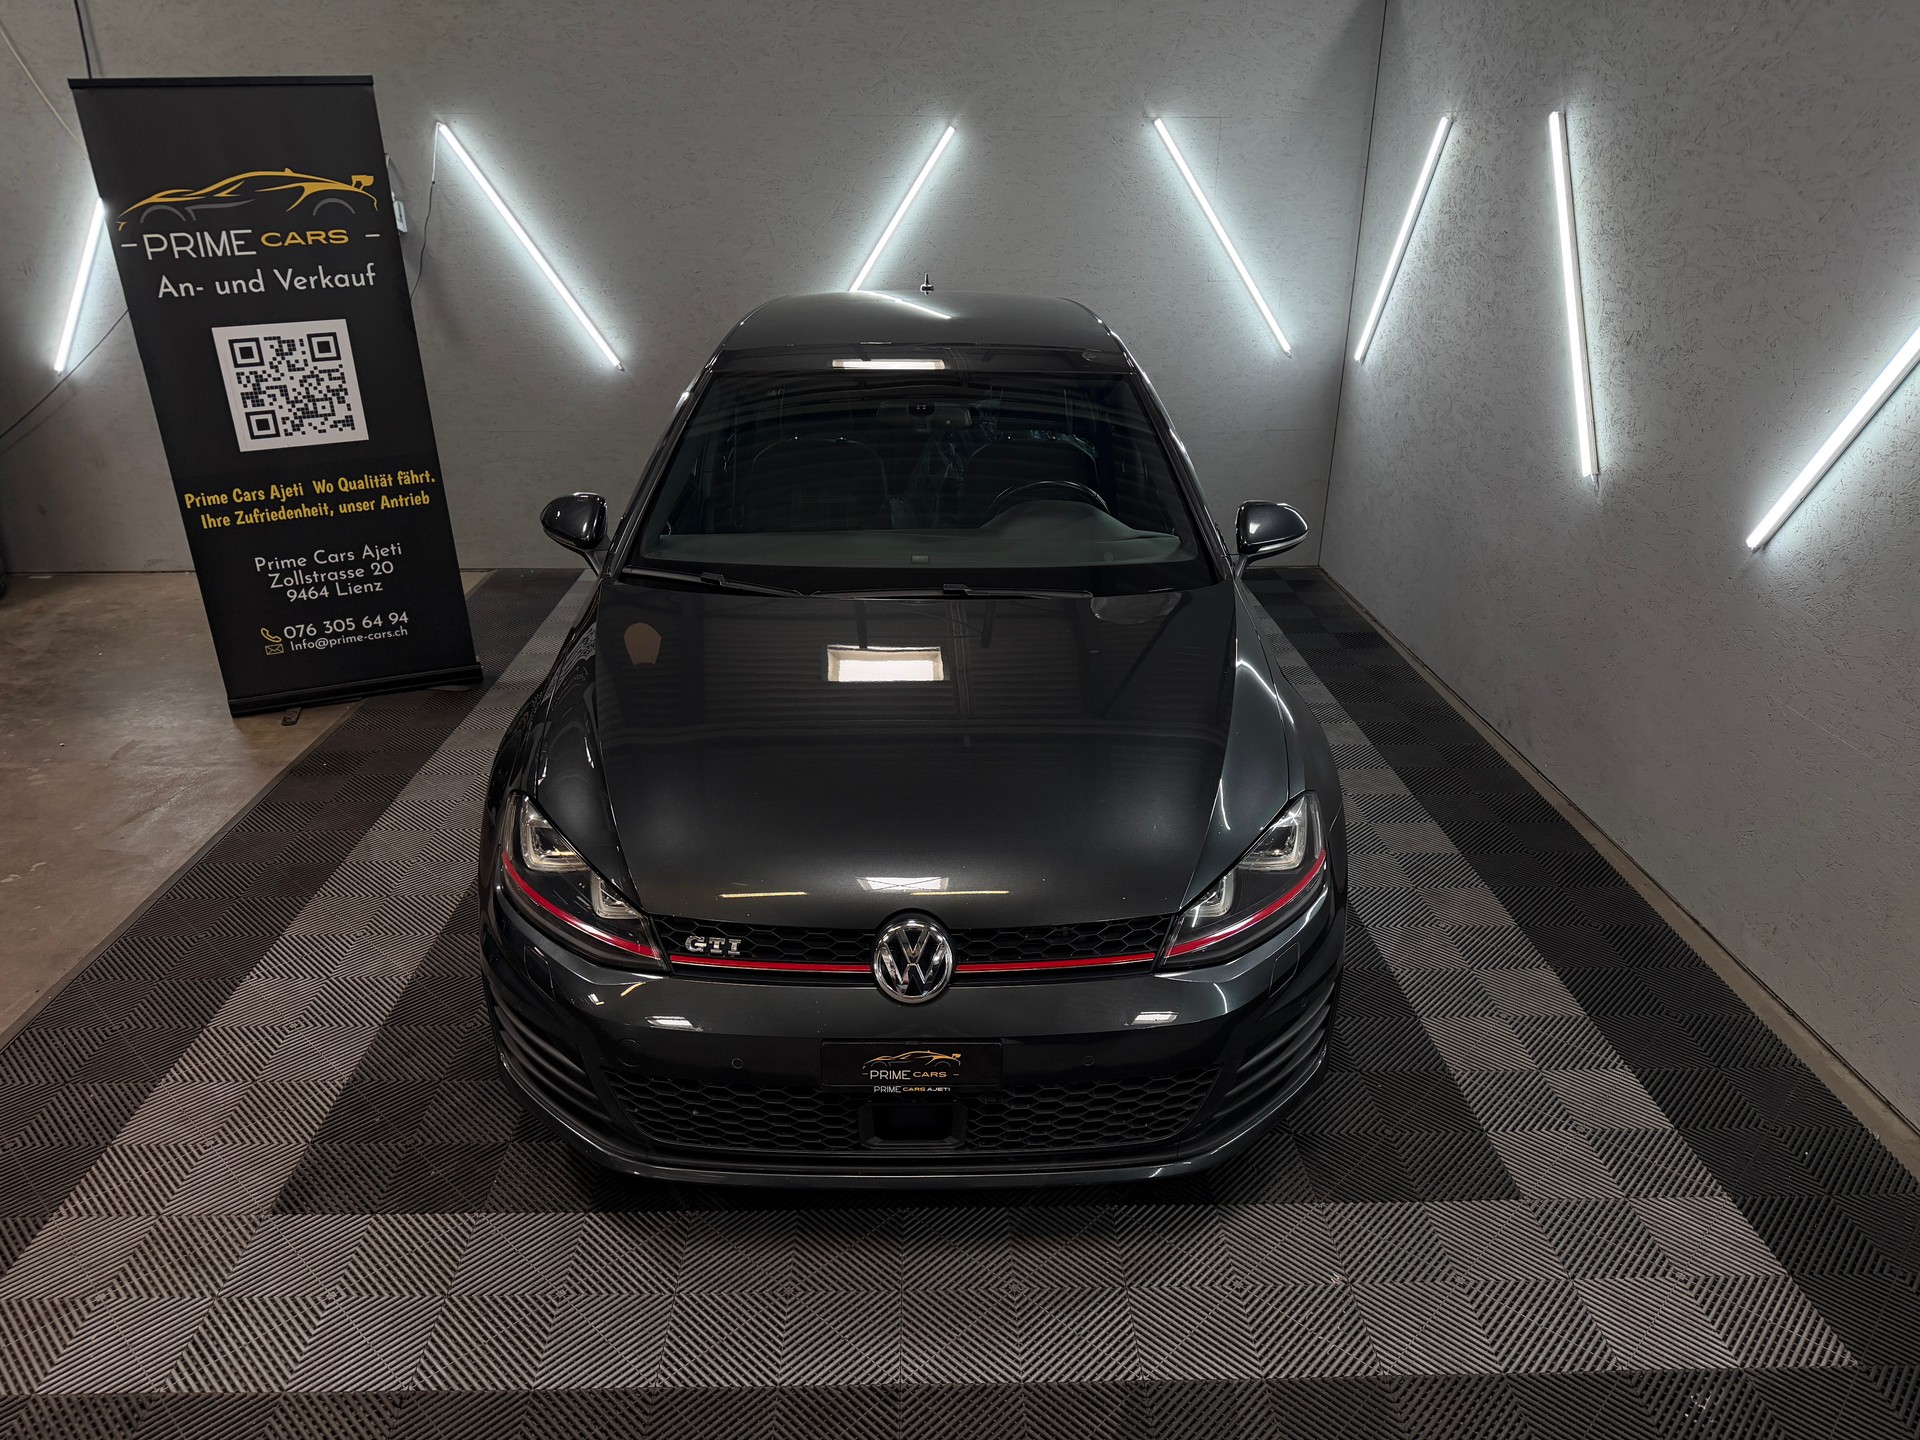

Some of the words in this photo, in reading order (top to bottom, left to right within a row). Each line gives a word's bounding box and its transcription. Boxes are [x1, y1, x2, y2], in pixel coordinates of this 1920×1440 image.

[143, 229, 256, 260] PRIME
[260, 229, 349, 247] CARS
[158, 275, 203, 298] An-
[215, 268, 265, 294] und
[273, 263, 376, 291] Verkauf
[184, 492, 228, 508] Prime
[233, 487, 265, 503] Cars
[270, 483, 304, 502] Ajeti
[312, 479, 334, 494] Wo
[338, 474, 393, 491] Qualität
[397, 470, 435, 486] fährt.
[201, 513, 231, 529] Ihre
[235, 504, 334, 526] Zufriedenheit,
[339, 500, 375, 514] unser
[380, 490, 430, 510] Antrieb
[254, 555, 307, 572] Prime
[313, 549, 355, 565] Cars
[362, 543, 402, 561] Ajeti
[268, 567, 365, 589] Zollstrasse
[370, 561, 394, 575] 20
[286, 587, 329, 602] 9464
[337, 580, 383, 597] Lienz
[284, 624, 317, 639] 076
[323, 618, 355, 634] 305
[362, 615, 383, 629] 64
[389, 611, 409, 624] 94
[290, 626, 408, 651] Info@prime-cars.ch
[685, 936, 742, 956] GTI
[870, 1070, 911, 1080] PRIME
